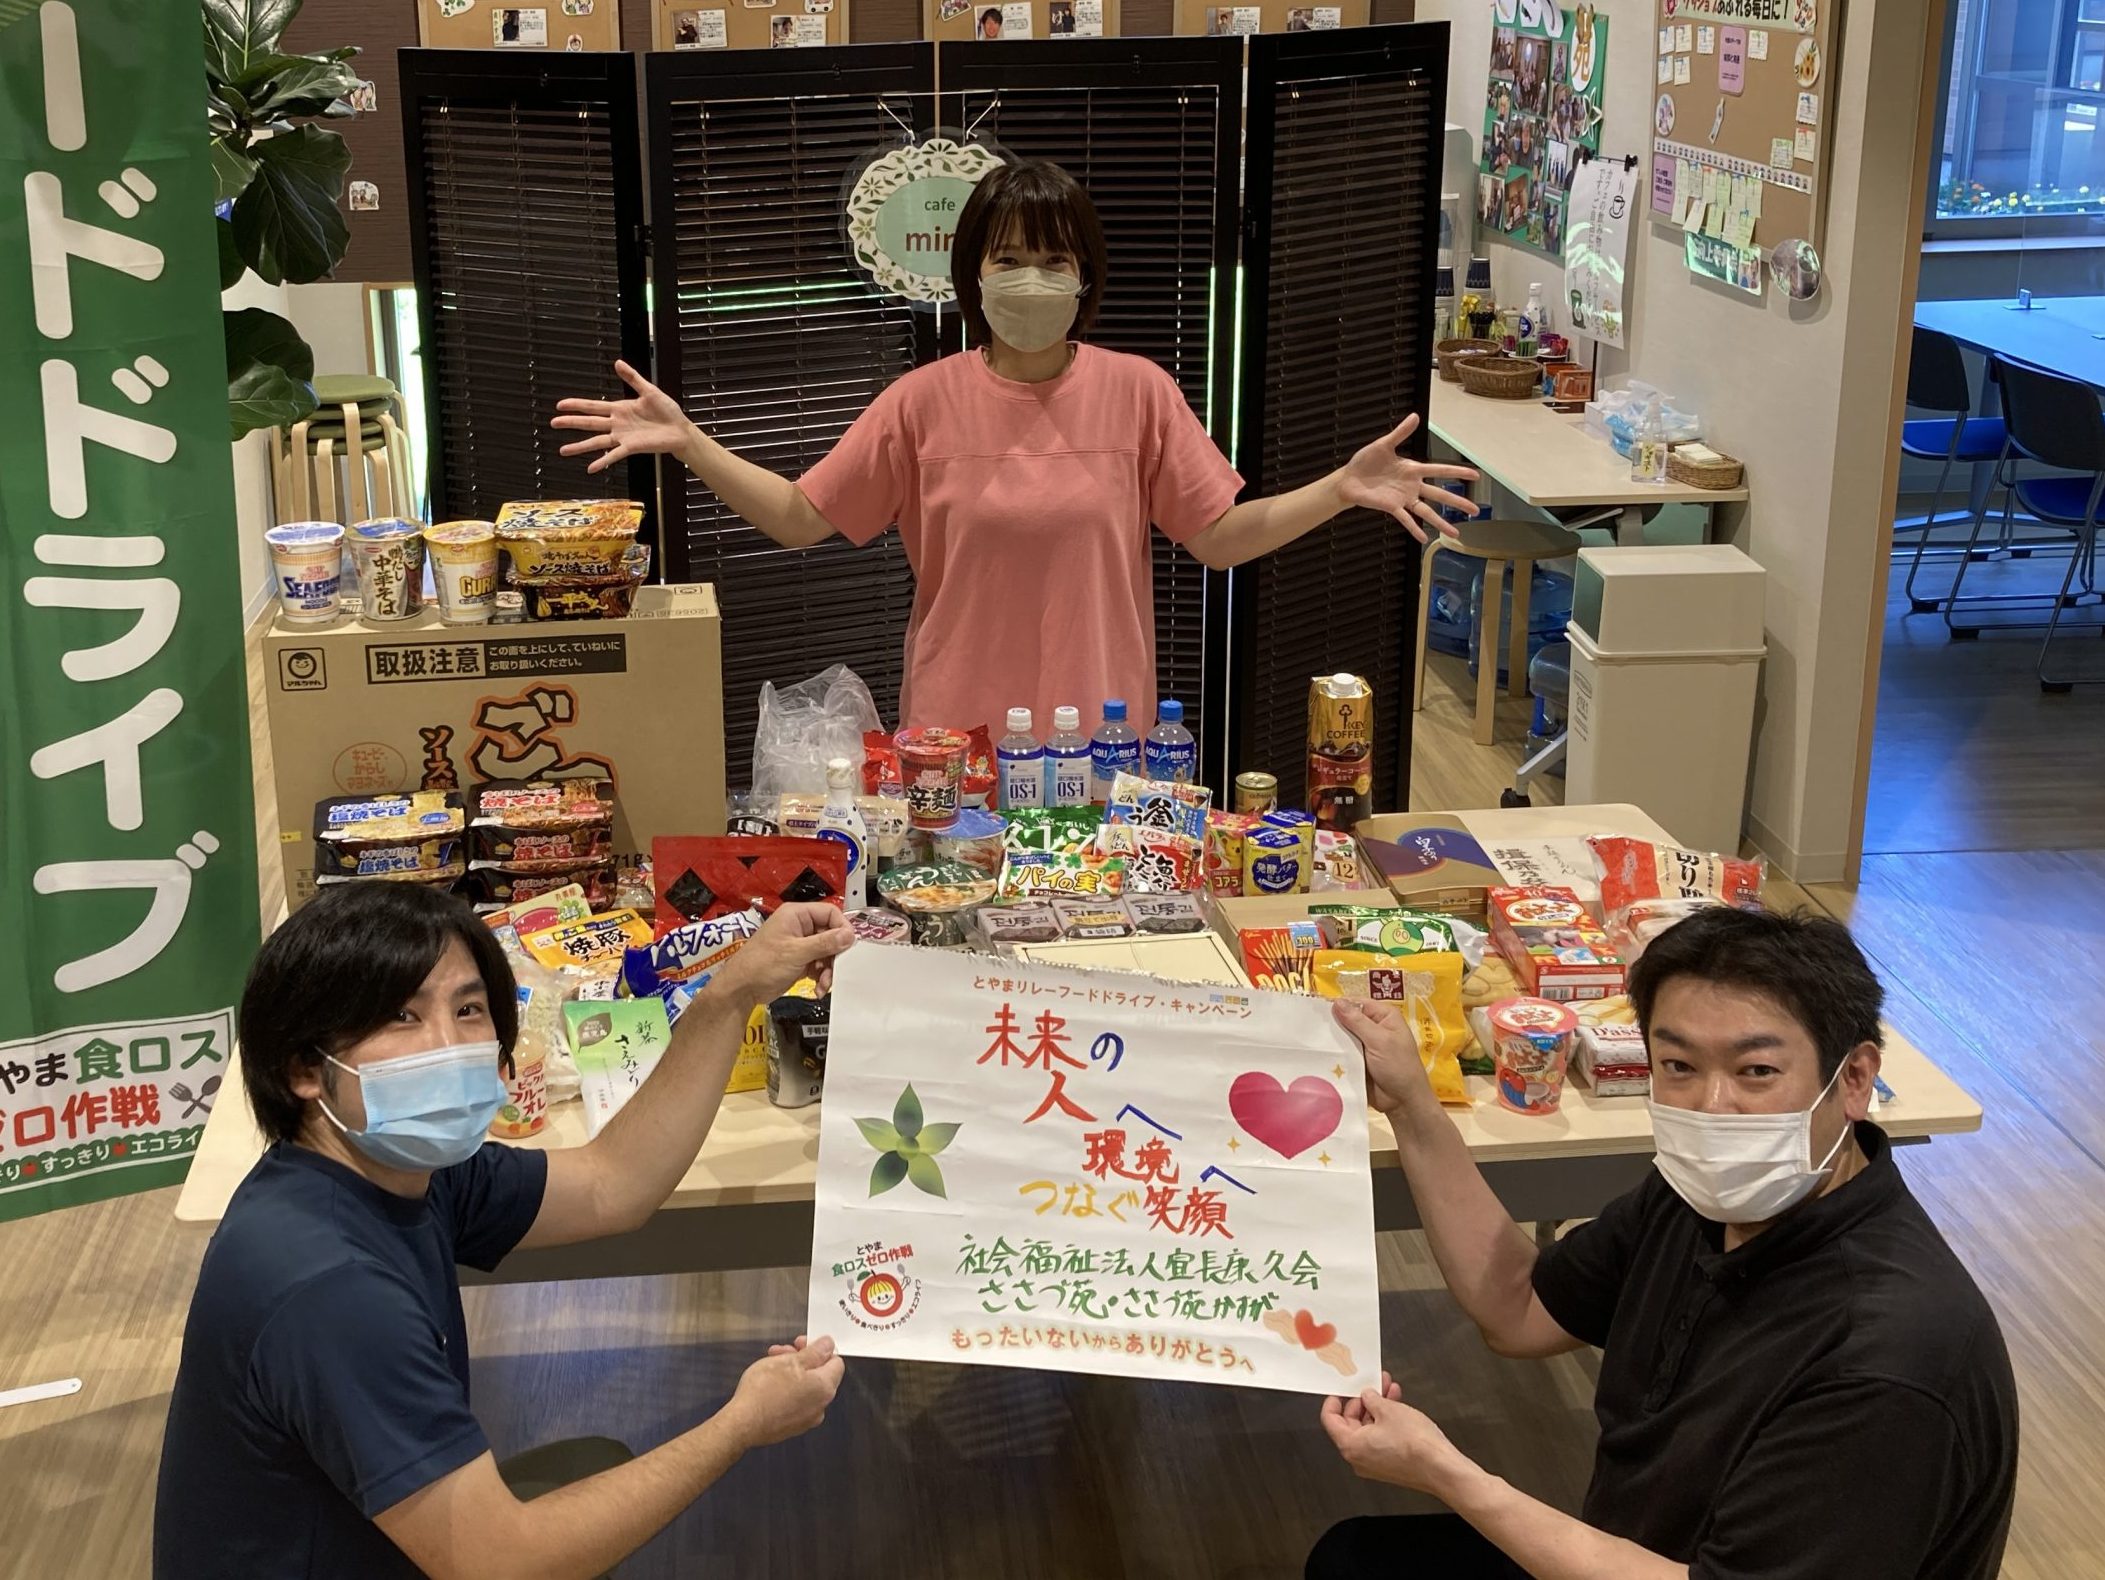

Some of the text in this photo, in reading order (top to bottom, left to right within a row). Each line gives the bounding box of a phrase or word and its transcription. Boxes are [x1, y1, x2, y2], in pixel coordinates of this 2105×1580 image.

[924, 197, 956, 211] cafe
[372, 554, 397, 616] 中華そば
[375, 647, 481, 678] 取扱注意
[488, 640, 622, 656] この面を上にして、ていねいに
[489, 657, 584, 672] お取り扱いください。
[1327, 730, 1367, 740] COFFEE
[353, 761, 386, 776] からし
[1091, 746, 1137, 764] AQUARIUS
[907, 783, 958, 813] 辛麺
[1009, 783, 1037, 799] OS-1
[1057, 781, 1085, 797] OS-1
[1016, 866, 1102, 894] パイの実
[562, 926, 632, 958] 焼豚
[973, 975, 1252, 1019] とやまリレーフードドライブ・キャンペーン
[976, 1002, 1125, 1072] 未来の
[0, 1084, 161, 1150] ロ作戦
[523, 1098, 547, 1116] オレ
[1023, 1070, 1183, 1140] 人へ
[42, 1143, 110, 1173] すっきり
[1083, 1129, 1257, 1195] 環境へ
[1019, 1181, 1234, 1239] つなぐ笑顔
[831, 1243, 914, 1278] 食ロスゼロ作戦
[857, 1240, 884, 1256] とやま
[951, 1326, 1255, 1373] もったいないからありがとうへ
